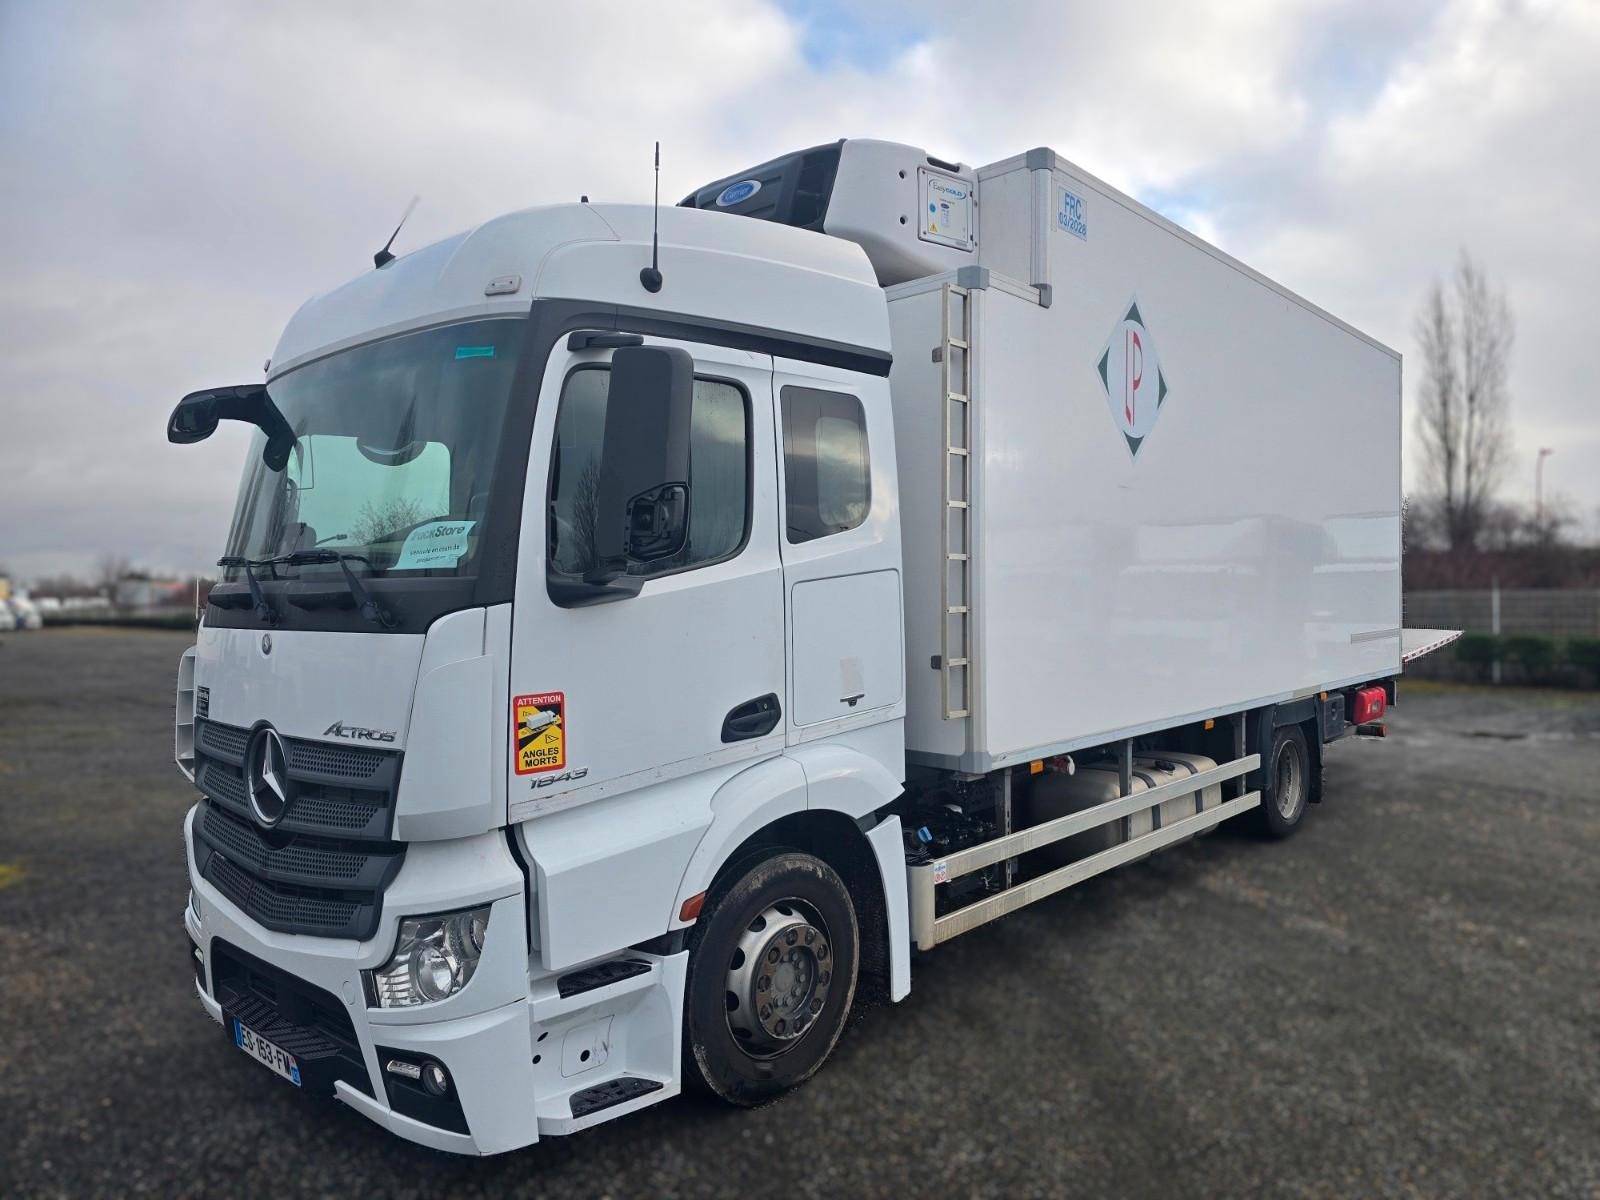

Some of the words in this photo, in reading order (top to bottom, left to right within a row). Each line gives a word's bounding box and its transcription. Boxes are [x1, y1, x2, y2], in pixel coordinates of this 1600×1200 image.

[1064, 192, 1082, 220] FRC
[517, 695, 561, 706] ATTENTION
[523, 747, 560, 759] ANGLES
[525, 756, 558, 768] MORTS
[530, 767, 588, 789] 1843
